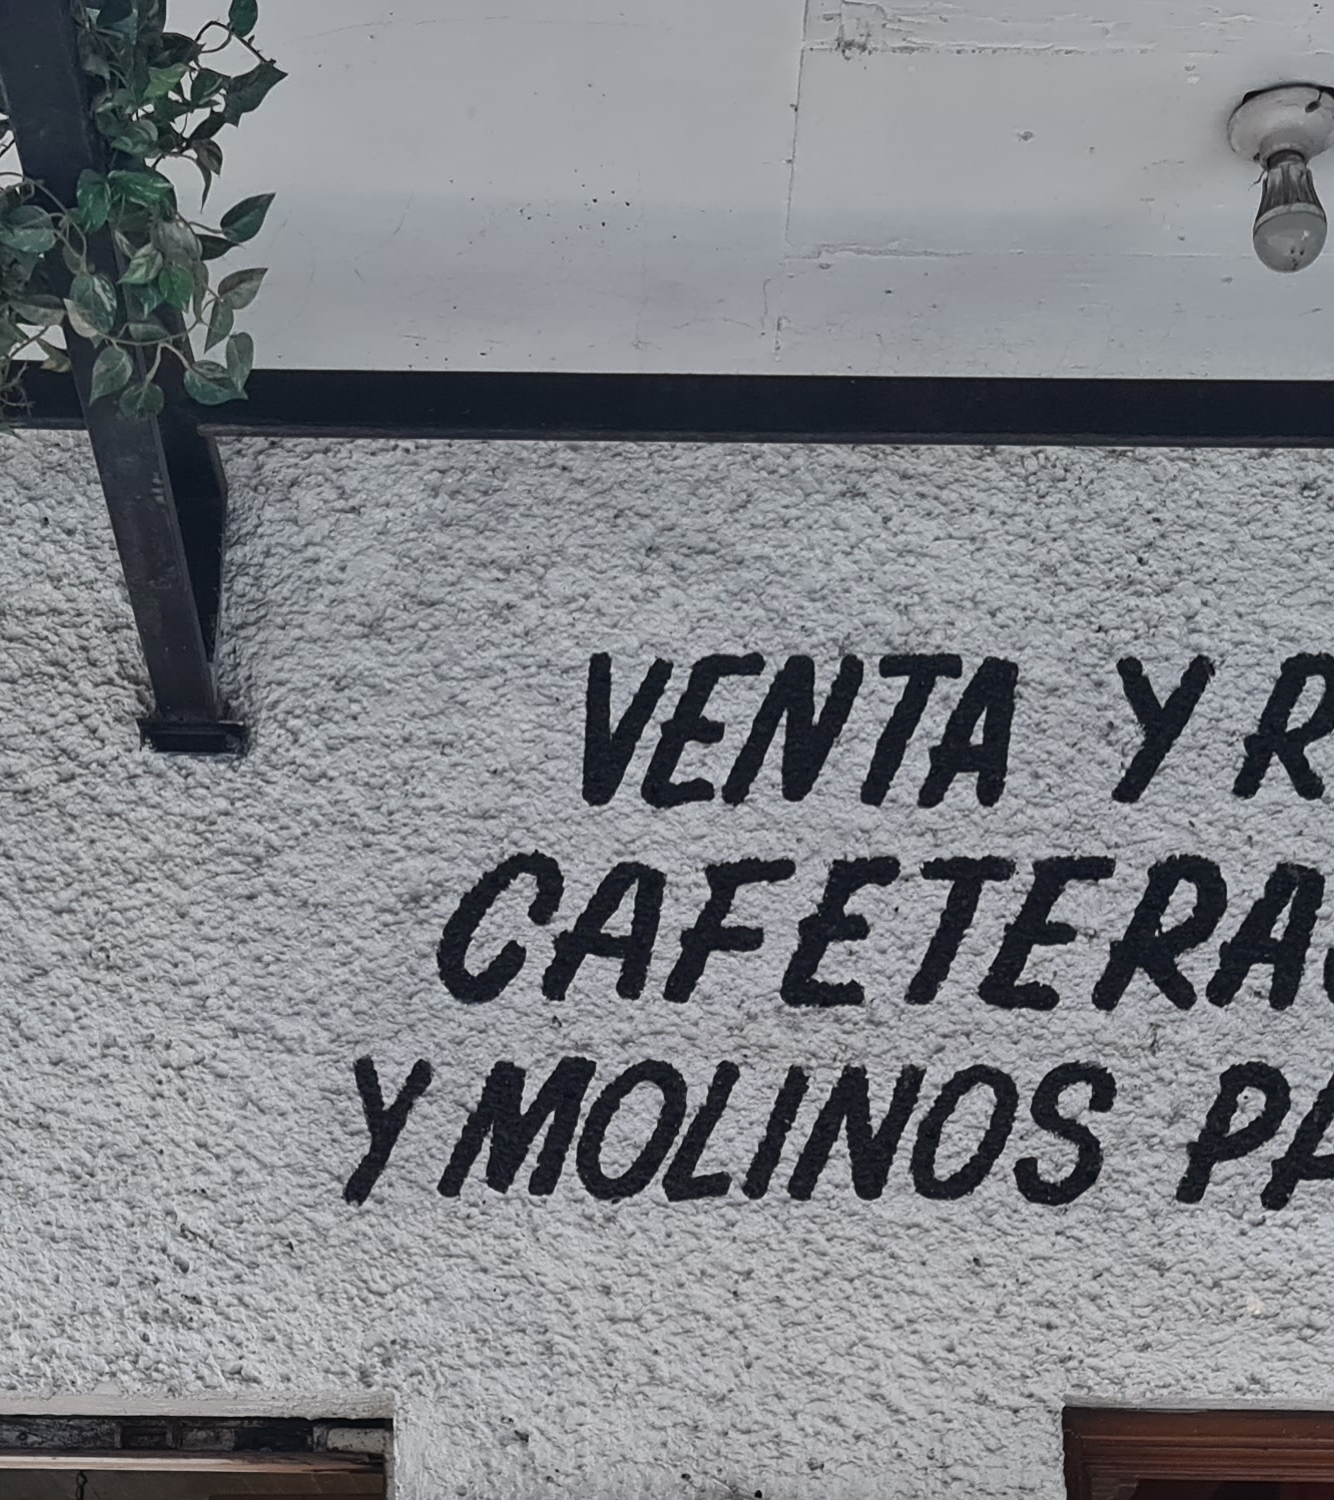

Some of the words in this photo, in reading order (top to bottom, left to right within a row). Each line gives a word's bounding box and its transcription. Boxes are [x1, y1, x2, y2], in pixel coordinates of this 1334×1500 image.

[581, 651, 1019, 806] VENTA
[1113, 653, 1216, 803] Y
[343, 1056, 432, 1202] Y
[436, 1056, 1116, 1205] MOLINOS
